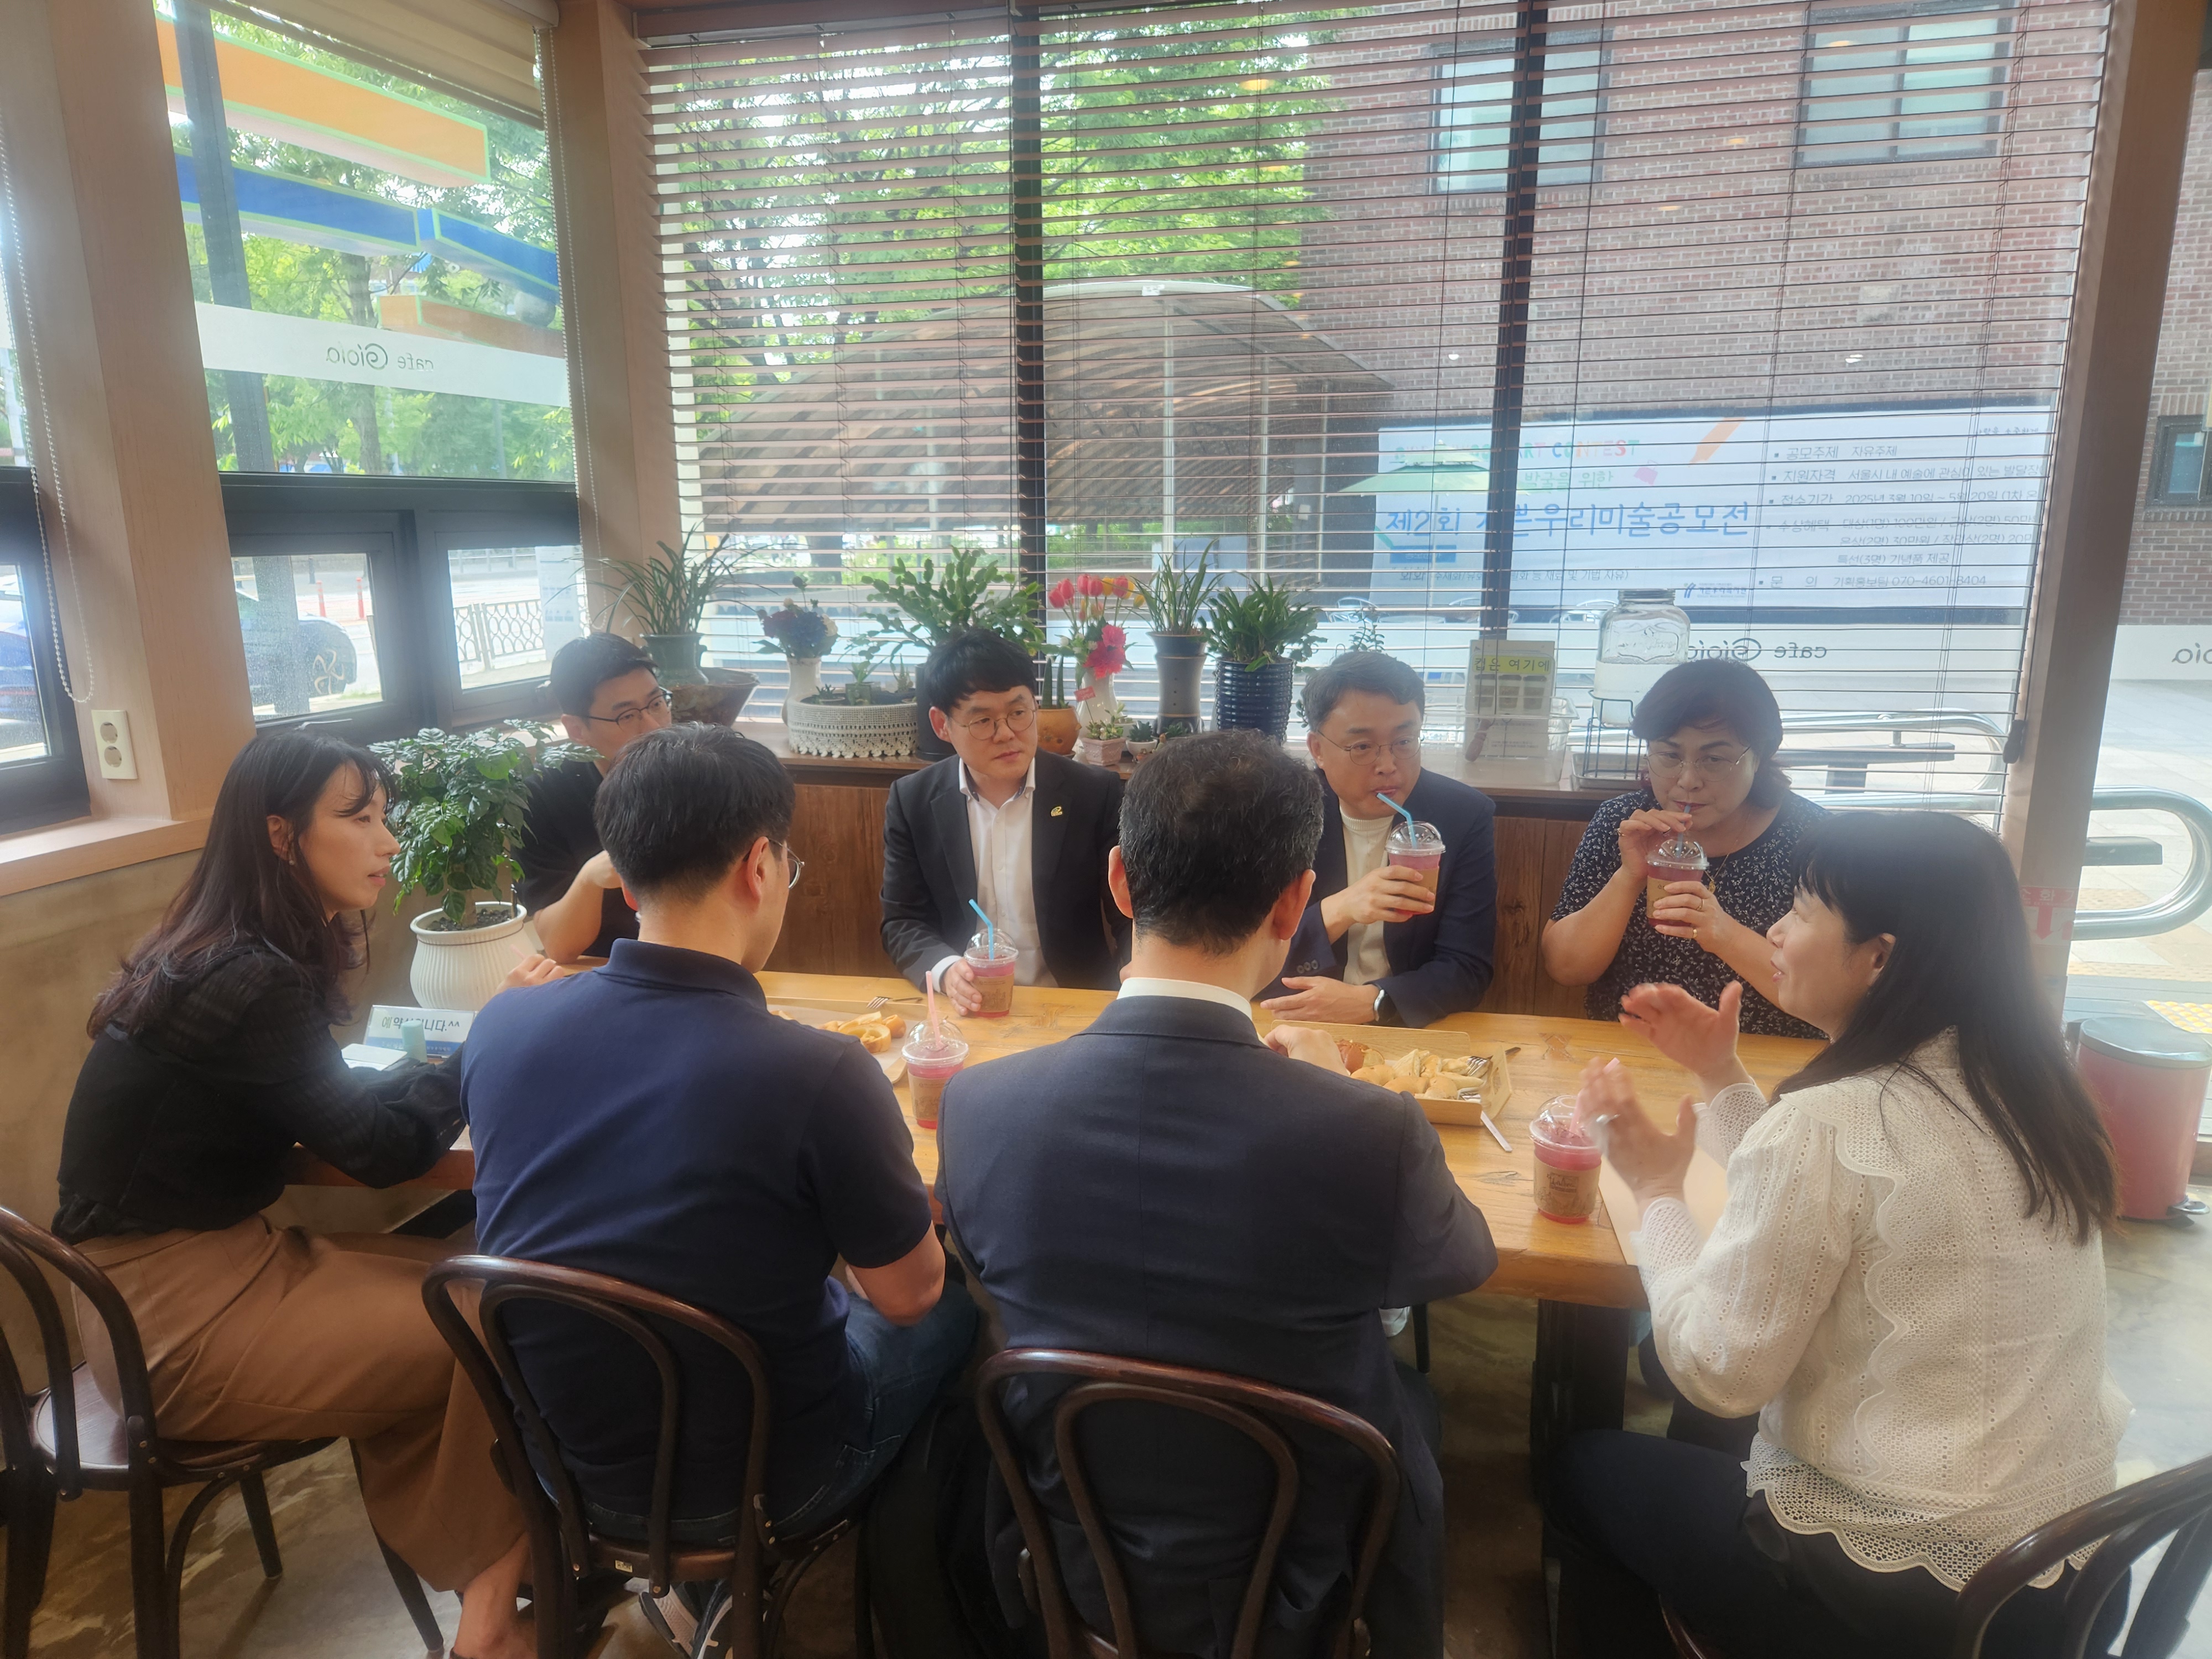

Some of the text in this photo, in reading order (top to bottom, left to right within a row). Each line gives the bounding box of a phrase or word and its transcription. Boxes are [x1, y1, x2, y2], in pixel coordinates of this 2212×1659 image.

[1517, 443, 1545, 458] RT
[1786, 445, 1897, 460] 공모주제 자유주제
[1578, 470, 1614, 491] 위한
[1783, 469, 1835, 483] 지원자격
[1849, 469, 1882, 480] 서울시
[1886, 468, 1897, 479] 내
[1901, 468, 1935, 479] 예술에
[1977, 466, 2000, 477] 있는
[1781, 494, 1833, 506] 접수기간
[1845, 494, 1885, 503] 2025년
[1386, 507, 1460, 536] 제2회
[1779, 519, 1829, 532] 수상혜택
[1838, 553, 1949, 565] 특선(3명) 기념품 제공
[1771, 576, 1986, 588] 문 의 기획홍보팀 070-4601-8404
[1509, 659, 1550, 672] 여기에
[382, 1016, 460, 1032] 예약니다.^^
